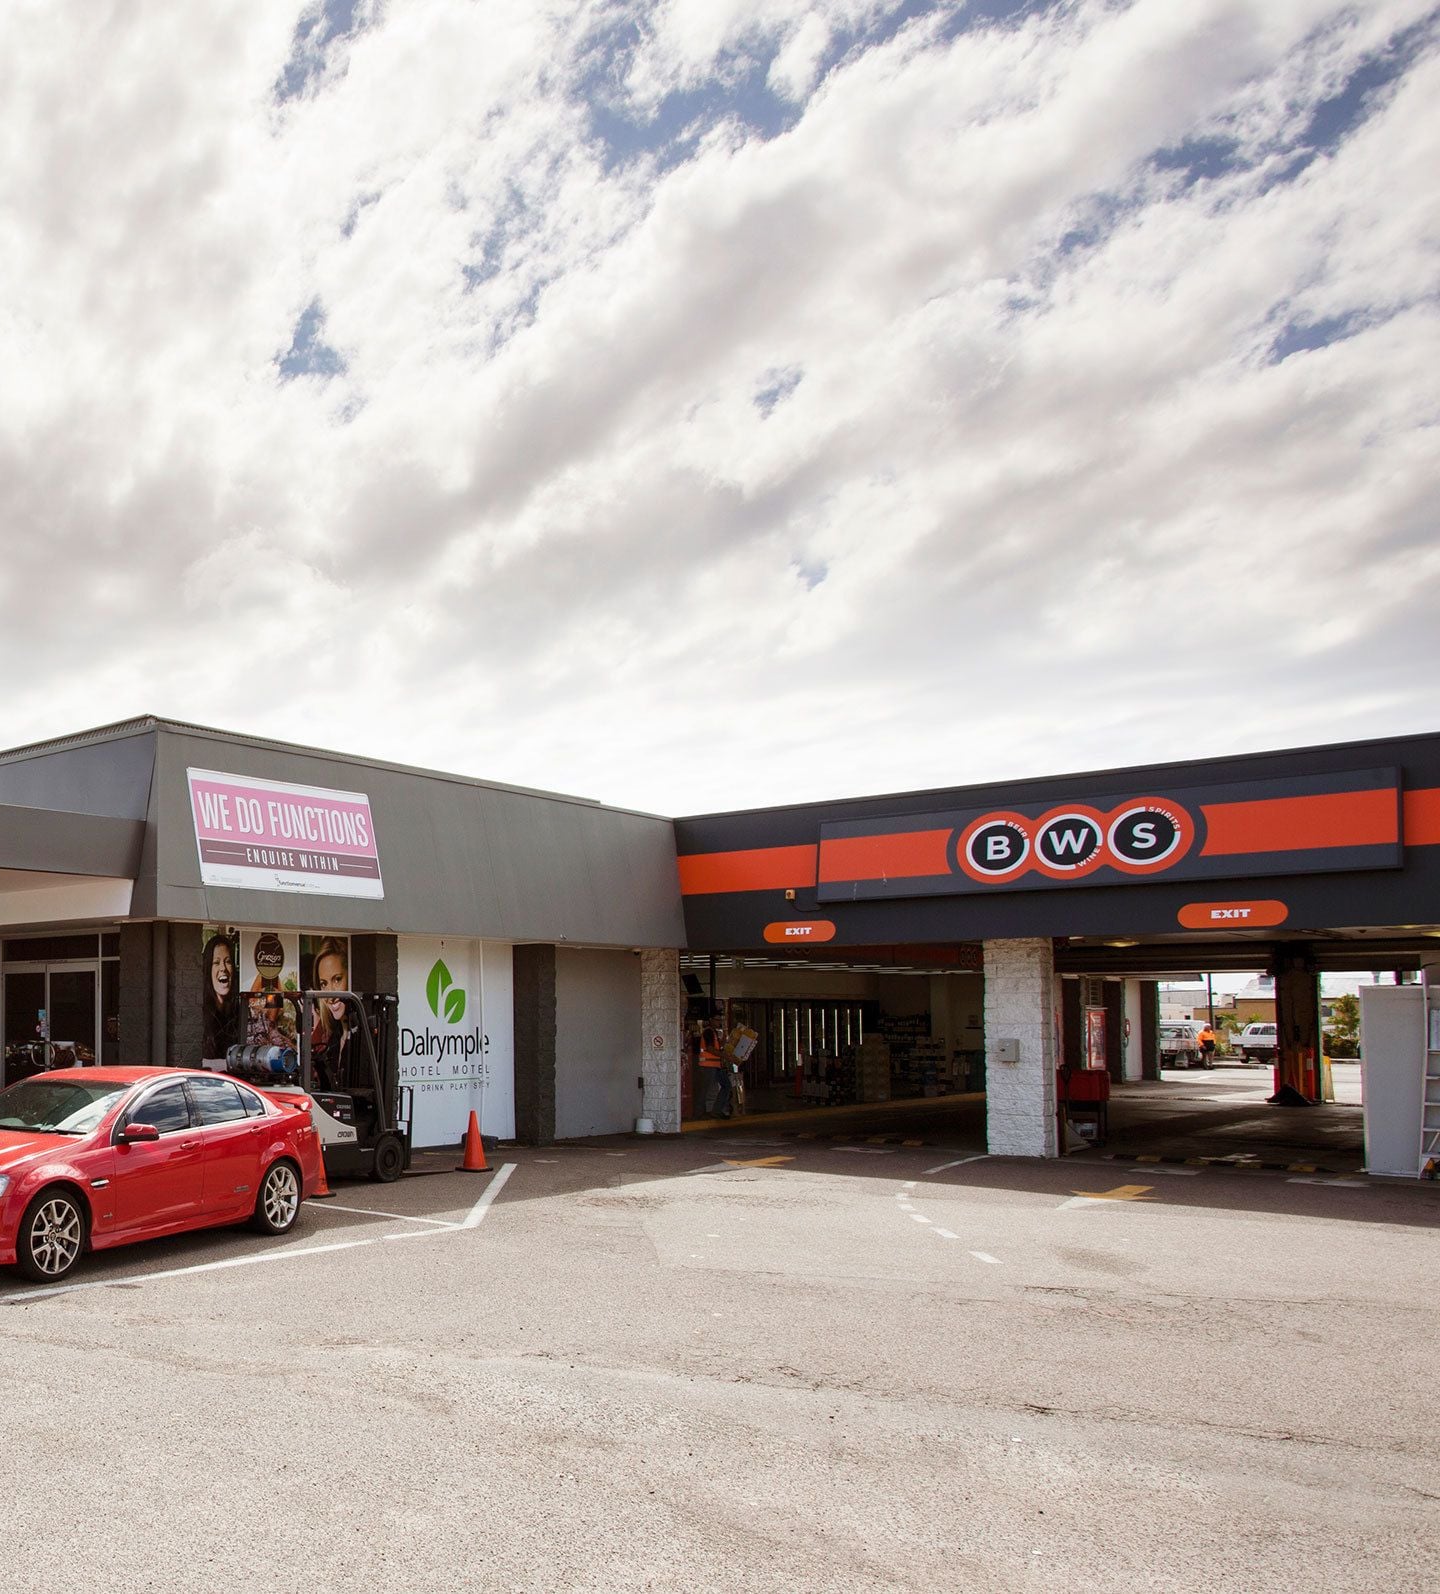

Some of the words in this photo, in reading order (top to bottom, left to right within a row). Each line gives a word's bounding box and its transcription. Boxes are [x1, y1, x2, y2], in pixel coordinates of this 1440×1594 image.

[197, 790, 233, 832] WE
[235, 796, 265, 836] DO
[267, 800, 369, 848] FUNCTIONS
[1148, 806, 1181, 831] SPIRITS
[1007, 821, 1027, 839] BEER
[246, 848, 295, 868] ENQUIRE
[299, 853, 340, 871] WITHIN
[1077, 847, 1101, 868] WINE
[1210, 908, 1252, 919] EXIT
[785, 927, 812, 936] EXIT
[401, 1027, 490, 1064] Dalrymple
[401, 1066, 441, 1077] HOTEL
[452, 1064, 490, 1075] MOTEL
[421, 1084, 444, 1092] DRINK
[450, 1083, 468, 1091] PLAY
